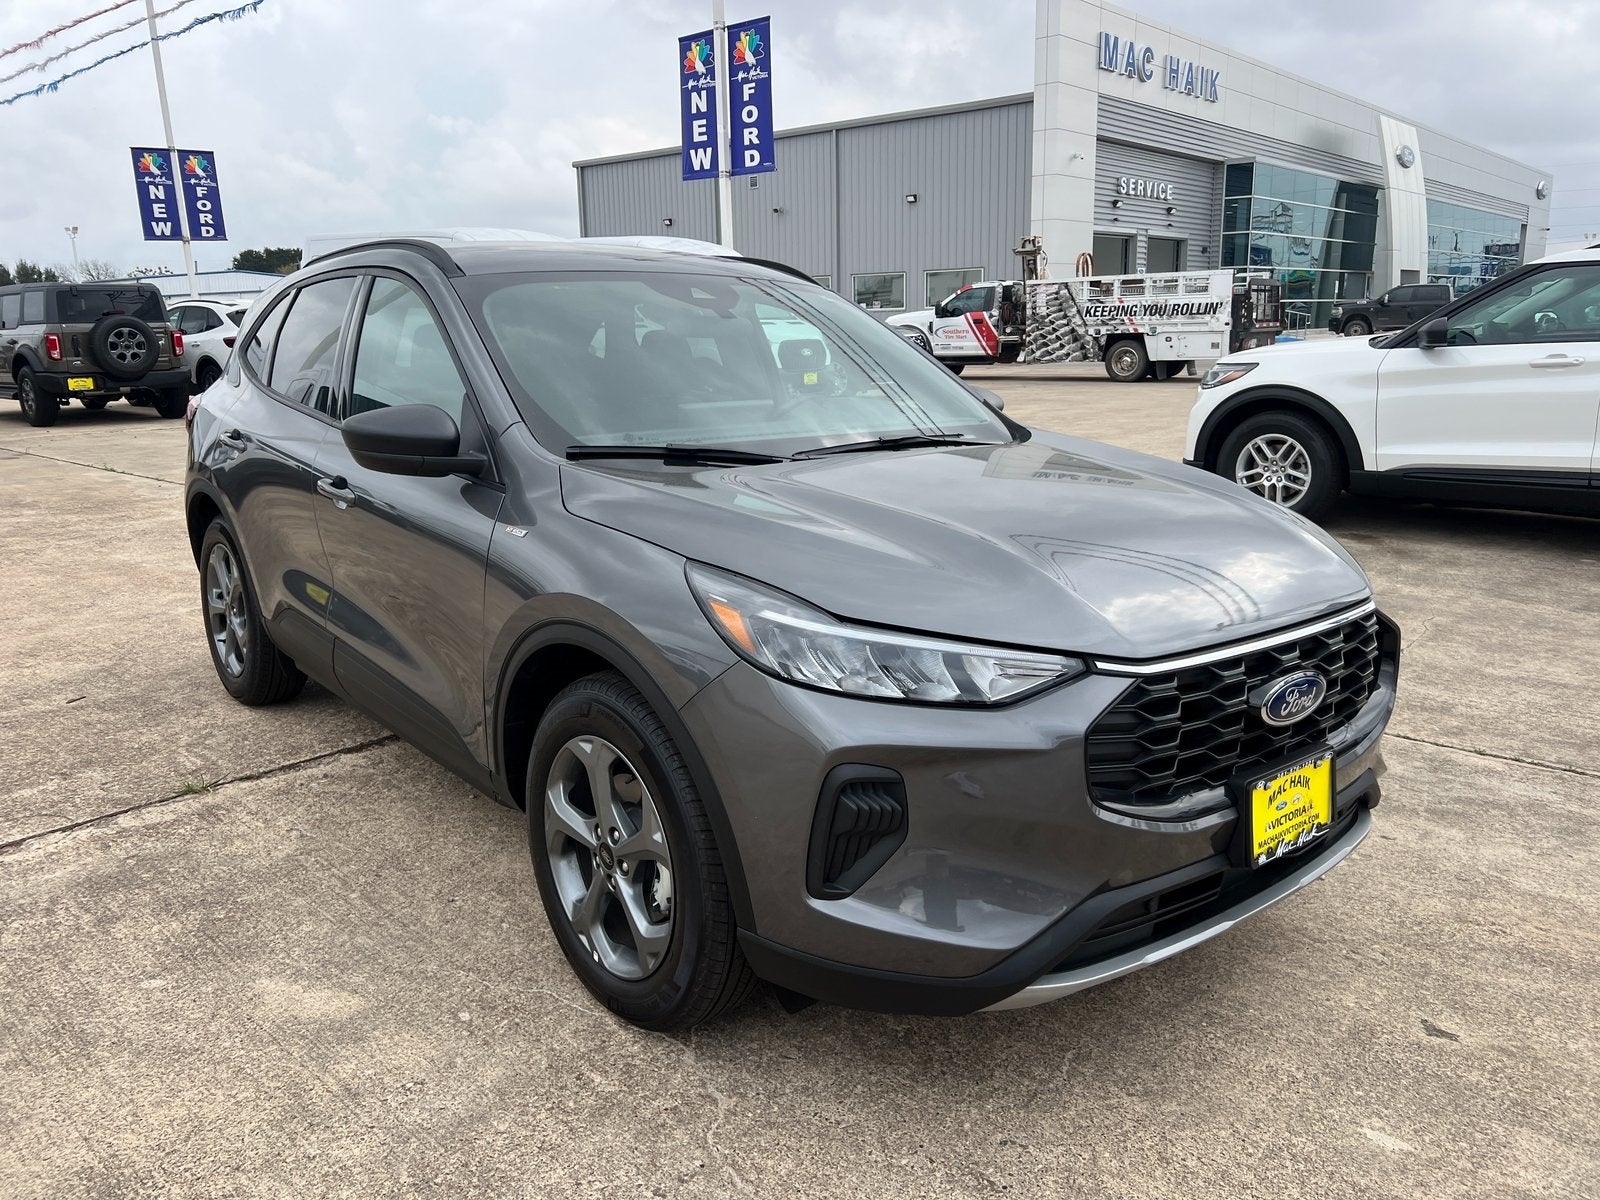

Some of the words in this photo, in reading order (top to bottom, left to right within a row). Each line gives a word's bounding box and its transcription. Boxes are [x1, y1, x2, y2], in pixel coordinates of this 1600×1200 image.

[1100, 31, 1154, 82] MAC
[1165, 54, 1220, 103] HAIK
[689, 90, 713, 171] NEW
[741, 82, 761, 168] FORD
[1118, 176, 1174, 200] SERVICE
[148, 185, 172, 236] NEW
[196, 186, 215, 237] FORD
[1084, 304, 1138, 318] KEEPING
[1141, 303, 1168, 317] YOU
[1170, 302, 1224, 317] ROLLIN'
[1280, 683, 1317, 717] Ford
[1268, 779, 1289, 809] MAC
[1289, 774, 1311, 790] HAIK
[1270, 804, 1307, 829] VICTORIA
